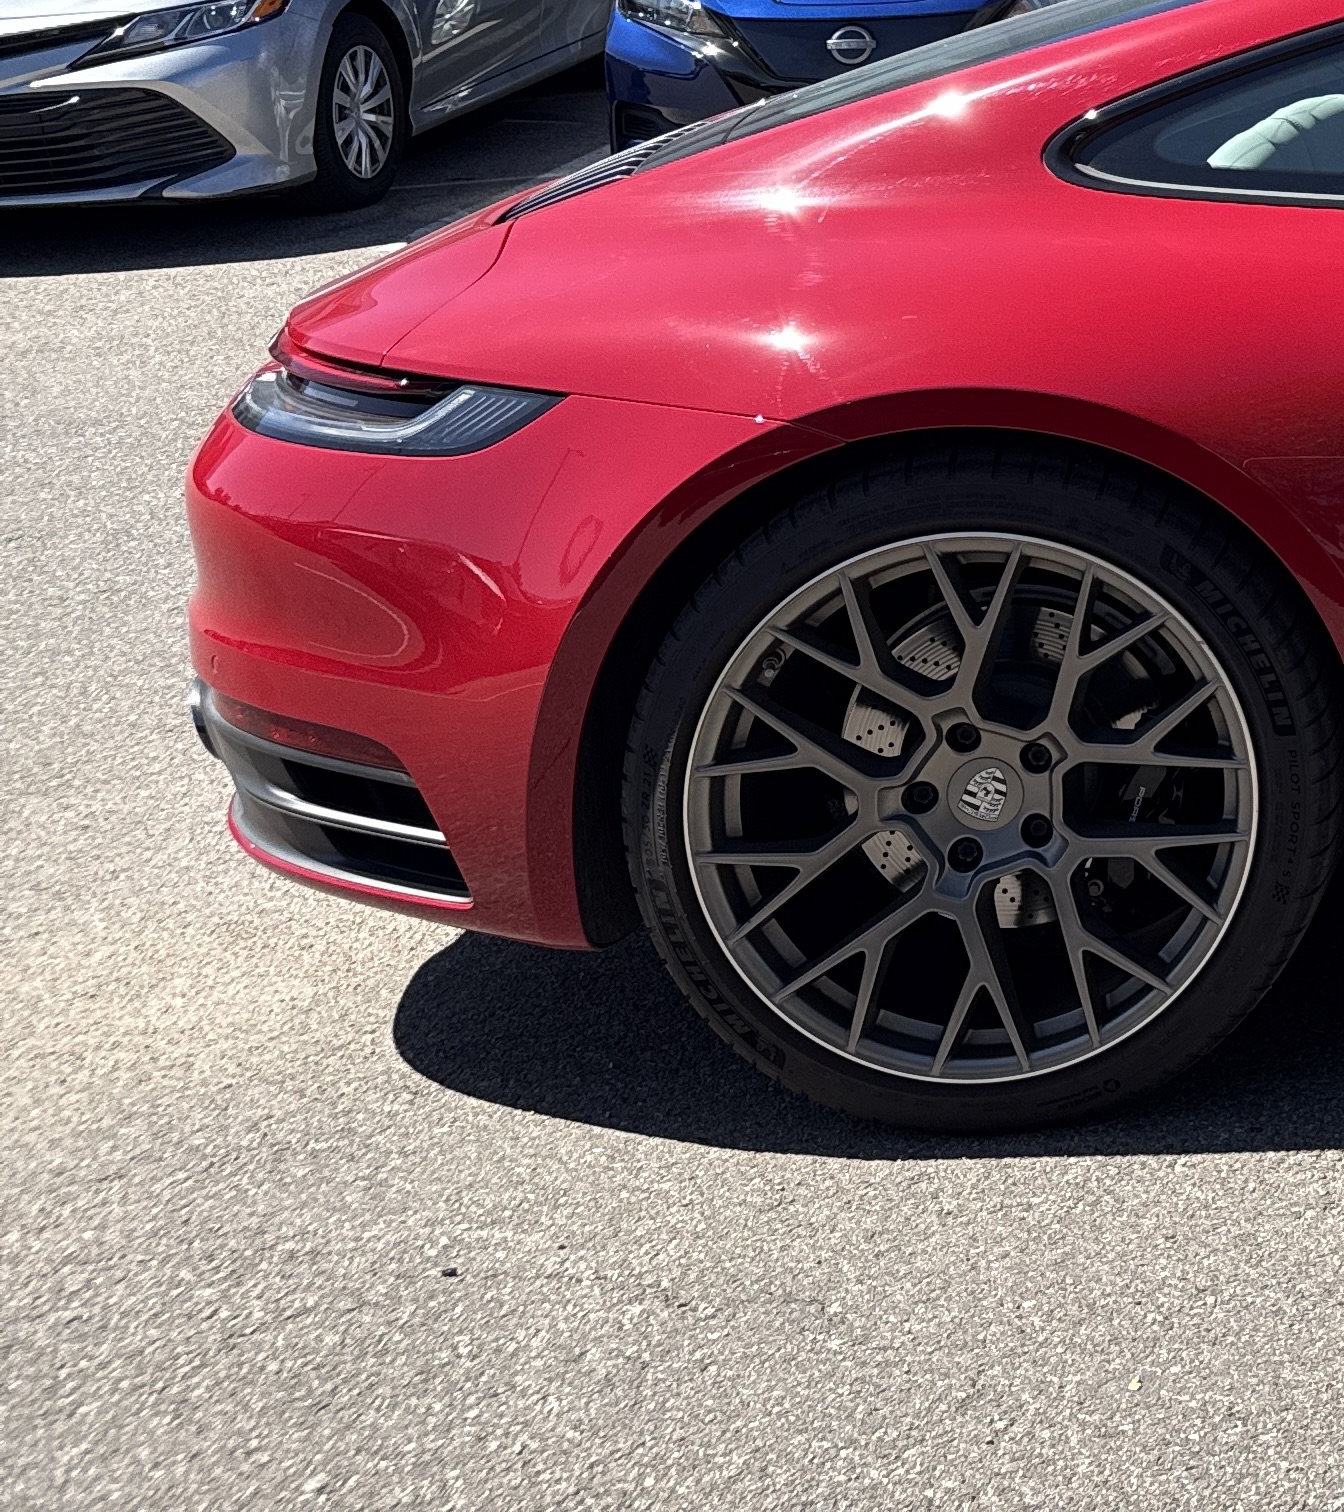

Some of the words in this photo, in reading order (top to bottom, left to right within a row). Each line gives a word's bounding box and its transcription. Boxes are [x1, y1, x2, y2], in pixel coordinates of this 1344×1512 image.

[1193, 577, 1293, 725] MICHELIN
[1287, 749, 1301, 795] PILOT
[1286, 801, 1301, 856] SPORT
[651, 889, 752, 1033] MICHELIN
